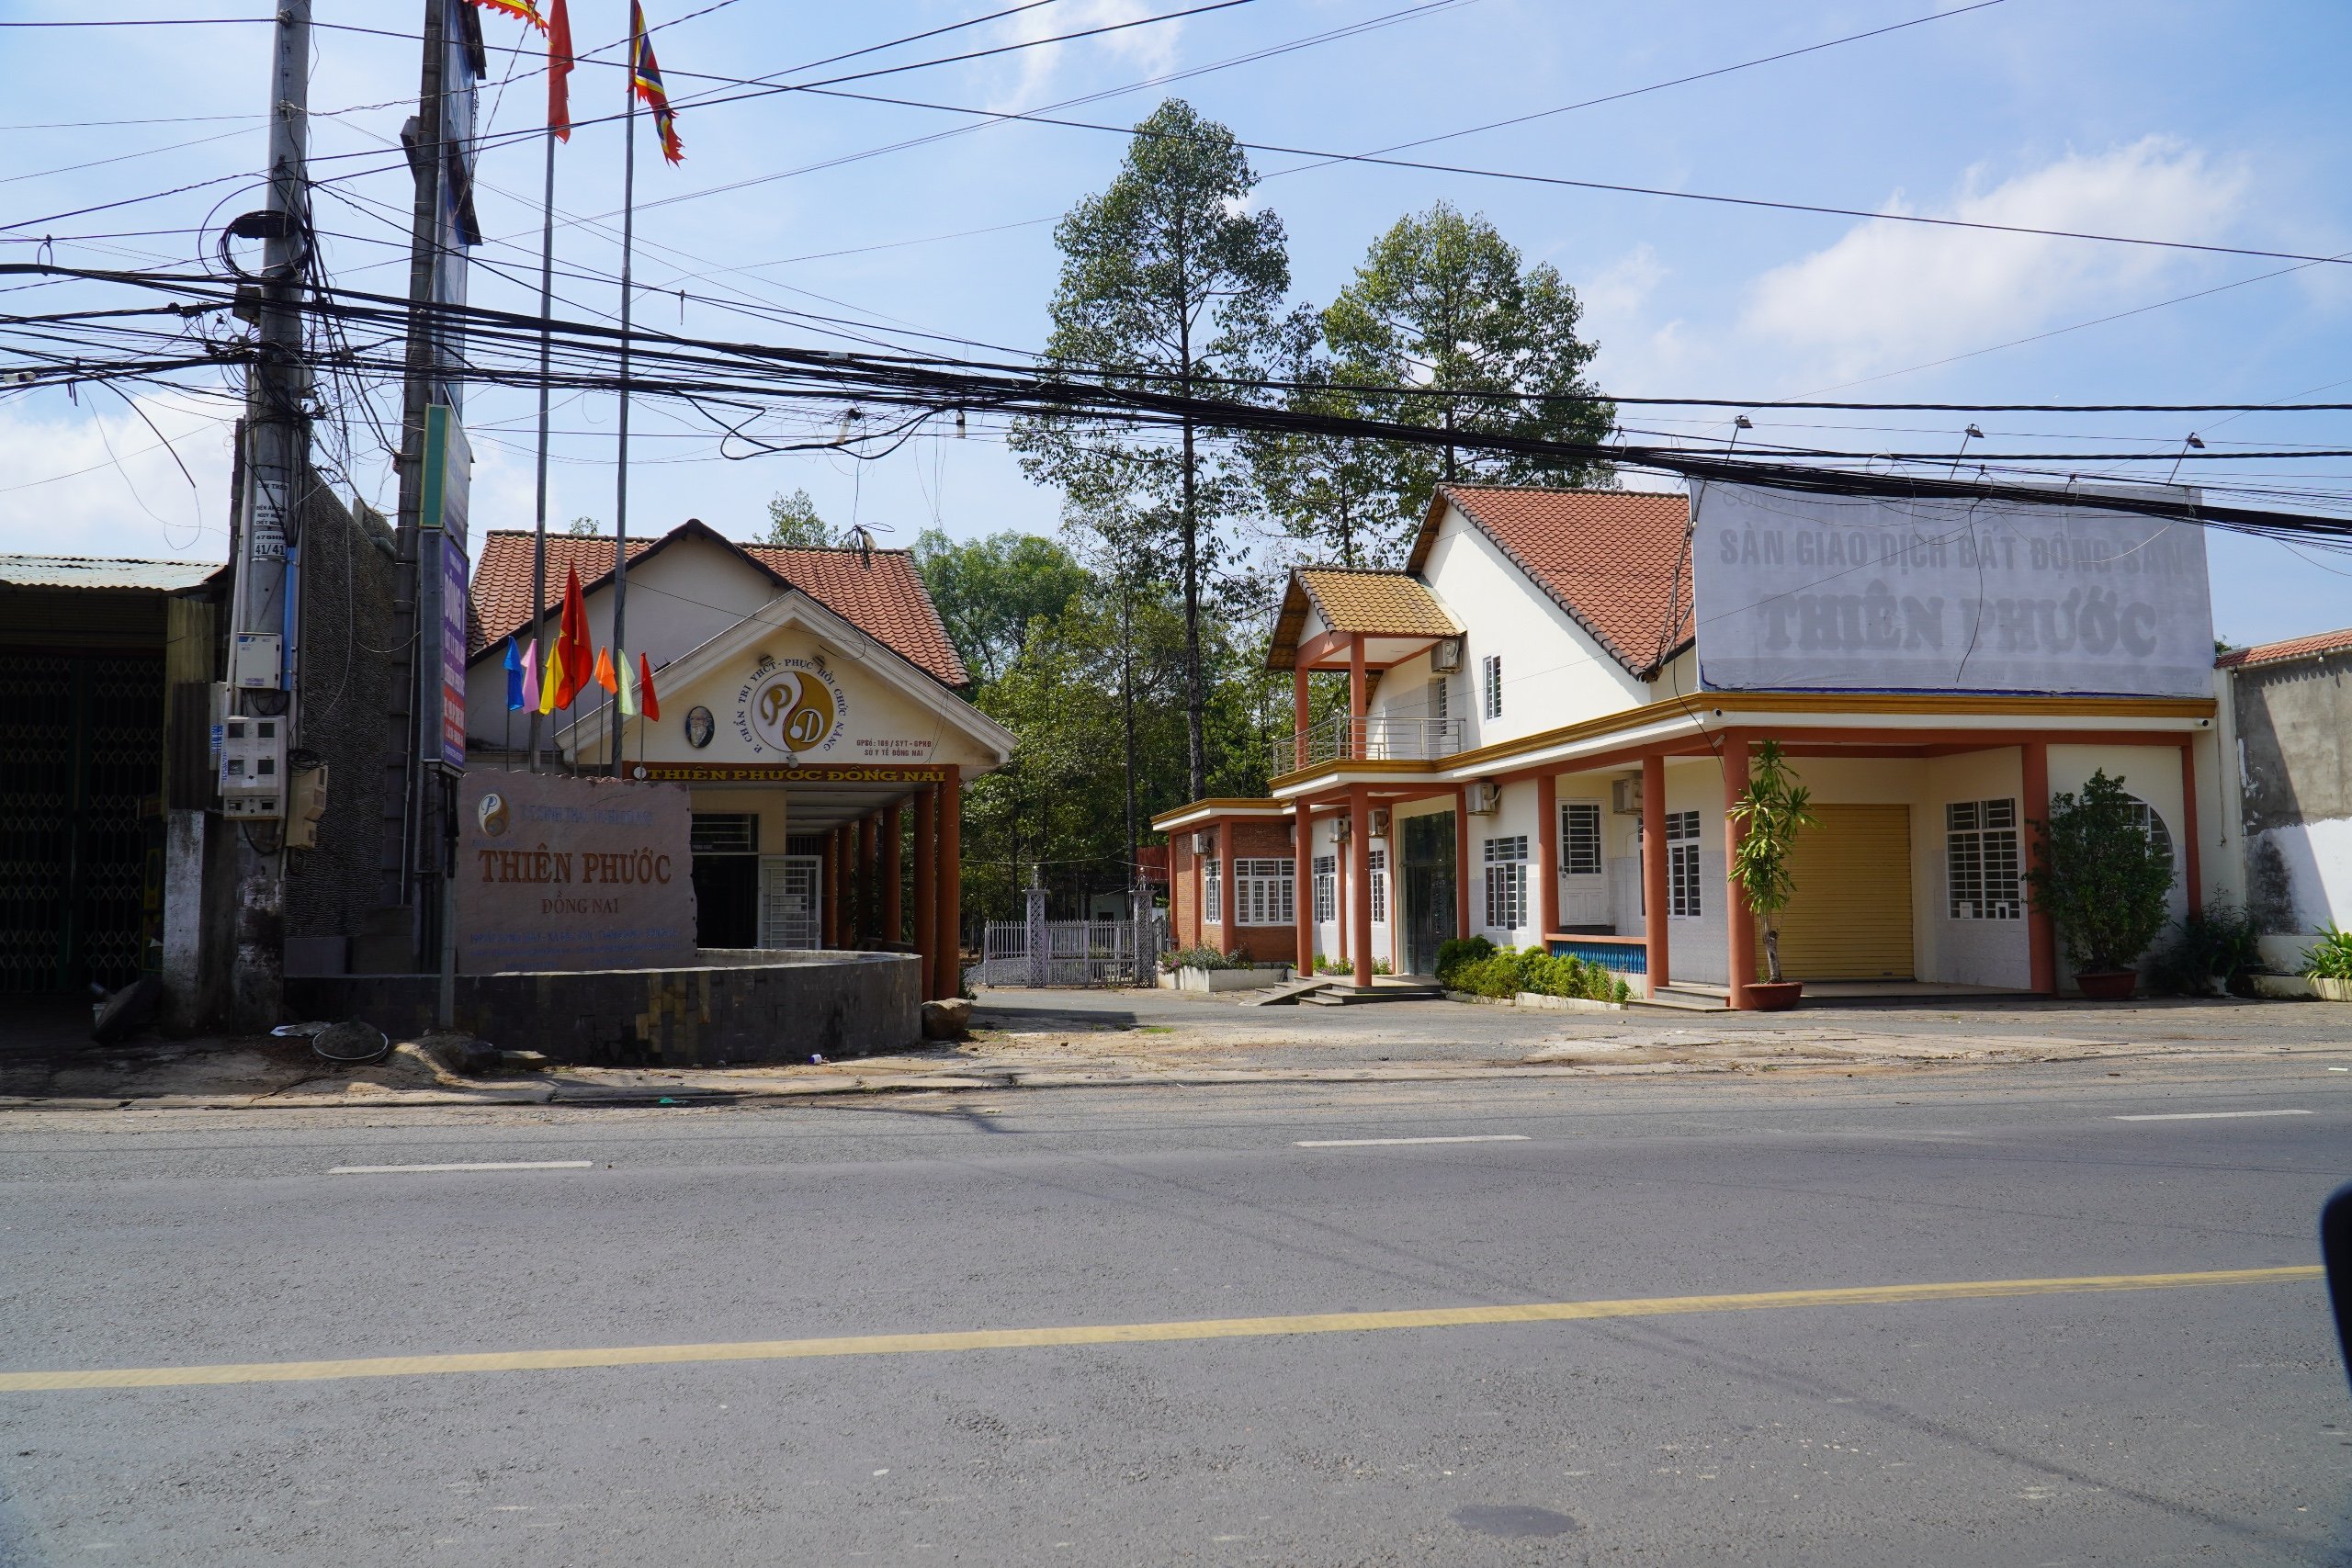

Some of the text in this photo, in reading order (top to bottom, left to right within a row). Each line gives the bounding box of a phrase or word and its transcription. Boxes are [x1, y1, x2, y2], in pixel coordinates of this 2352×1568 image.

[255, 544, 285, 555] 41/41
[1720, 520, 1784, 565] SÀN
[1796, 531, 1868, 567] GIAO
[1879, 534, 1947, 576] DỊCH
[1959, 525, 2017, 570] BẤT
[2030, 533, 2112, 580] ĐỘNG
[1758, 579, 2157, 656] THIÊN PHƯỚC
[750, 662, 776, 682] YHCT
[785, 659, 813, 670] PHỤC
[817, 669, 836, 686] HỒI
[738, 684, 752, 704] TRỊ
[833, 688, 849, 716] CHỨC
[823, 721, 846, 751] NĂNG
[753, 743, 763, 754] P.
[648, 766, 727, 780] THIÊN
[827, 765, 899, 781] ĐỒNG
[902, 771, 946, 782] NAI
[478, 842, 672, 885] THIÊN PHƯỚC
[541, 890, 619, 915] ĐỒNG NAI
